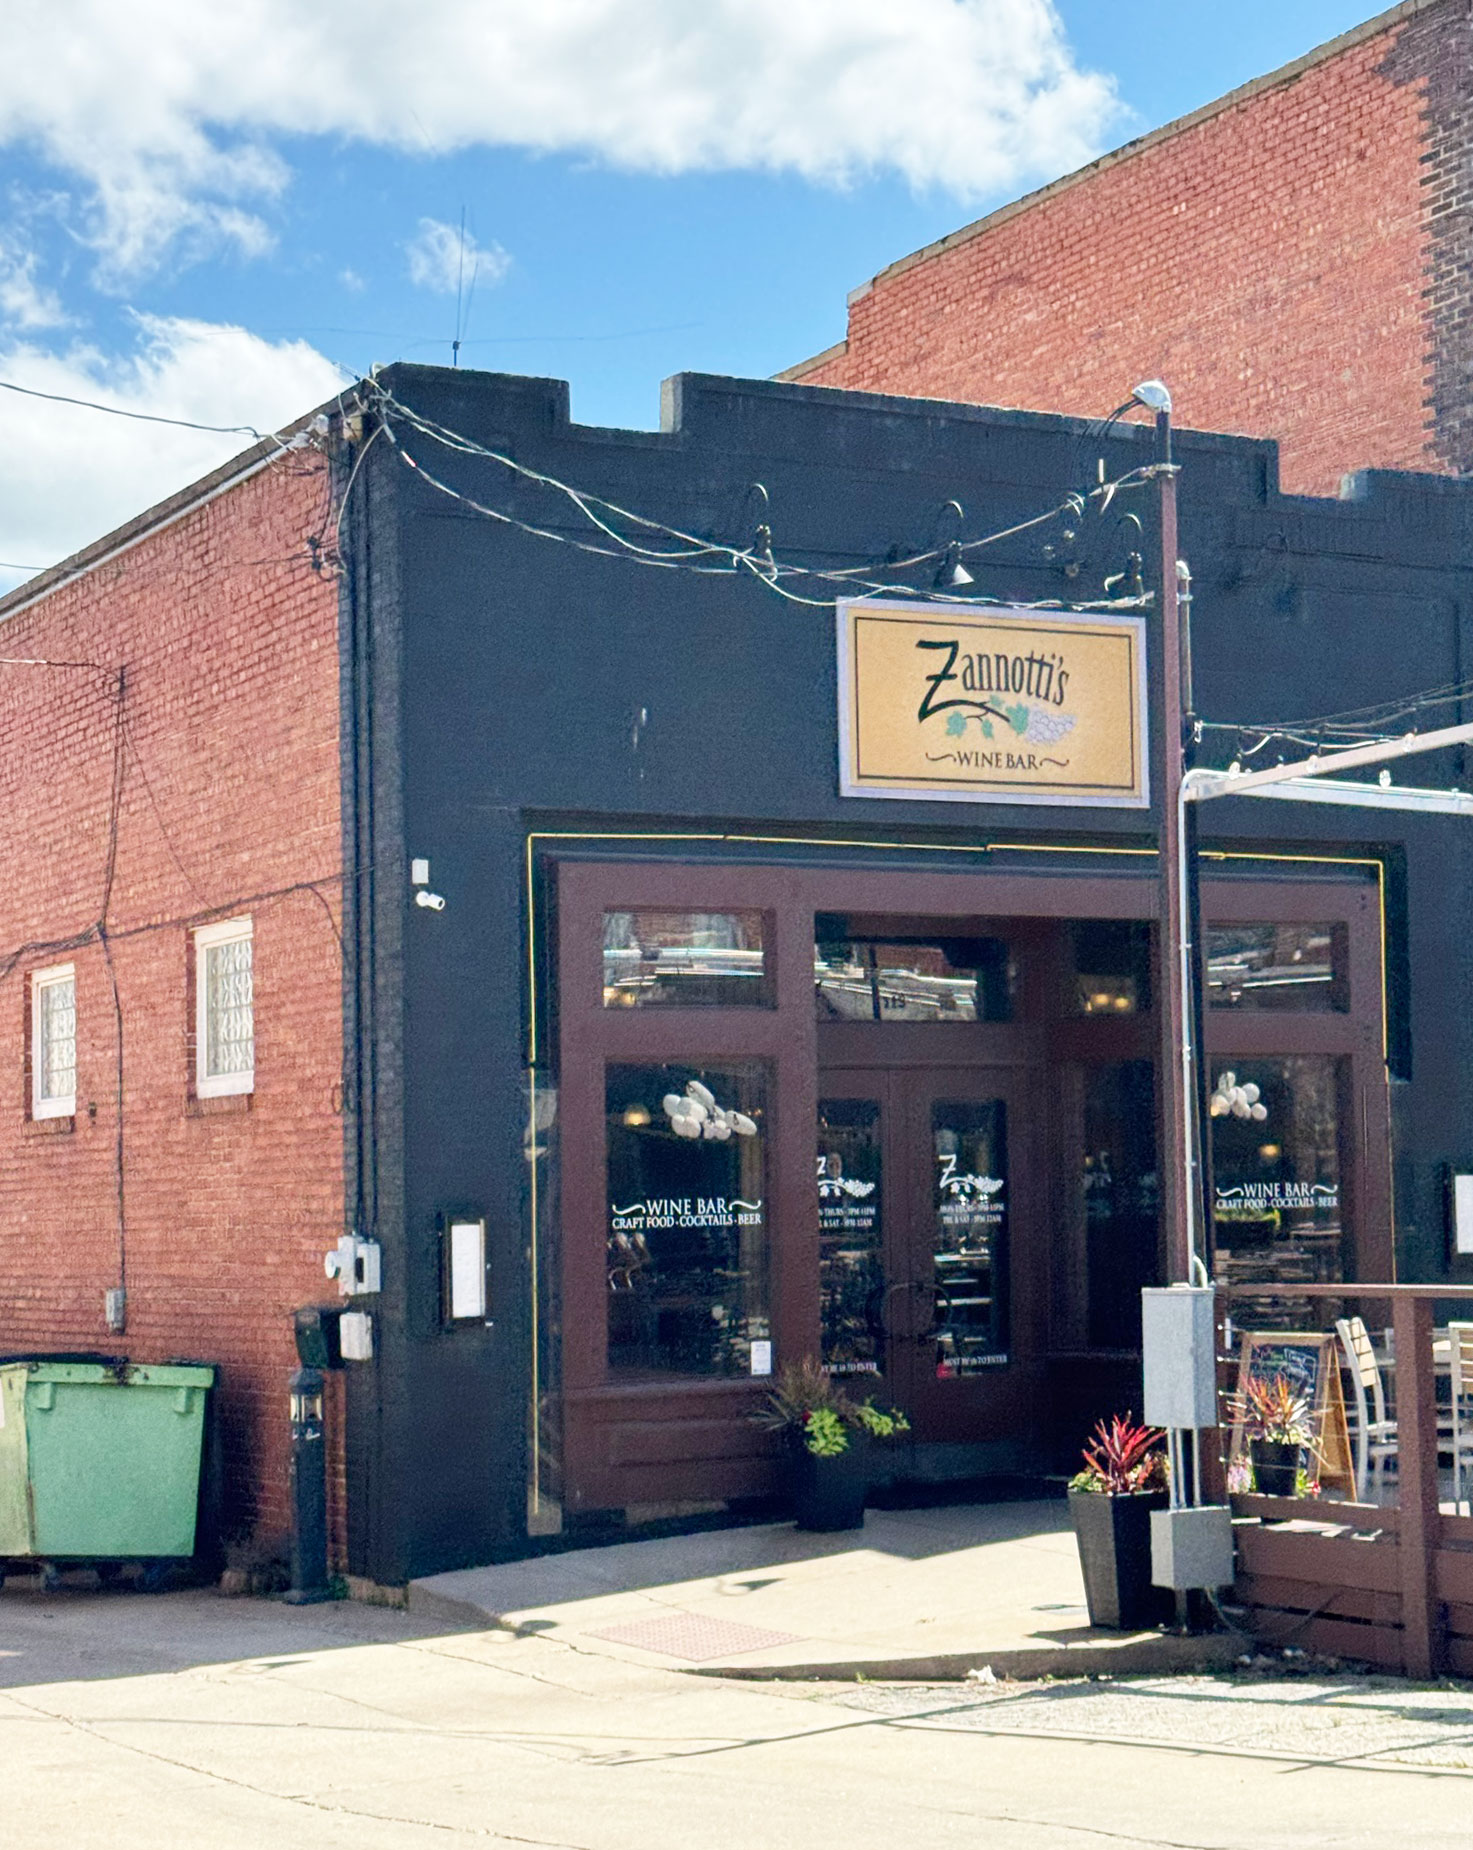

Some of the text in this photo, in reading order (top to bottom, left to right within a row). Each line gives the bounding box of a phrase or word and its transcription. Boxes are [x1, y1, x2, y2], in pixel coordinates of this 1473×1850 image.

[916, 639, 1070, 723] Zannotti's
[956, 751, 1040, 770] WINE BAR
[1243, 1182, 1310, 1197] WINE BAR
[646, 1197, 728, 1215] WINE BAR
[1216, 1196, 1338, 1209] CRAFT FOOD COCKTAILS BEER
[612, 1213, 762, 1229] CRAFT FOOD COCKTAILS BEER
